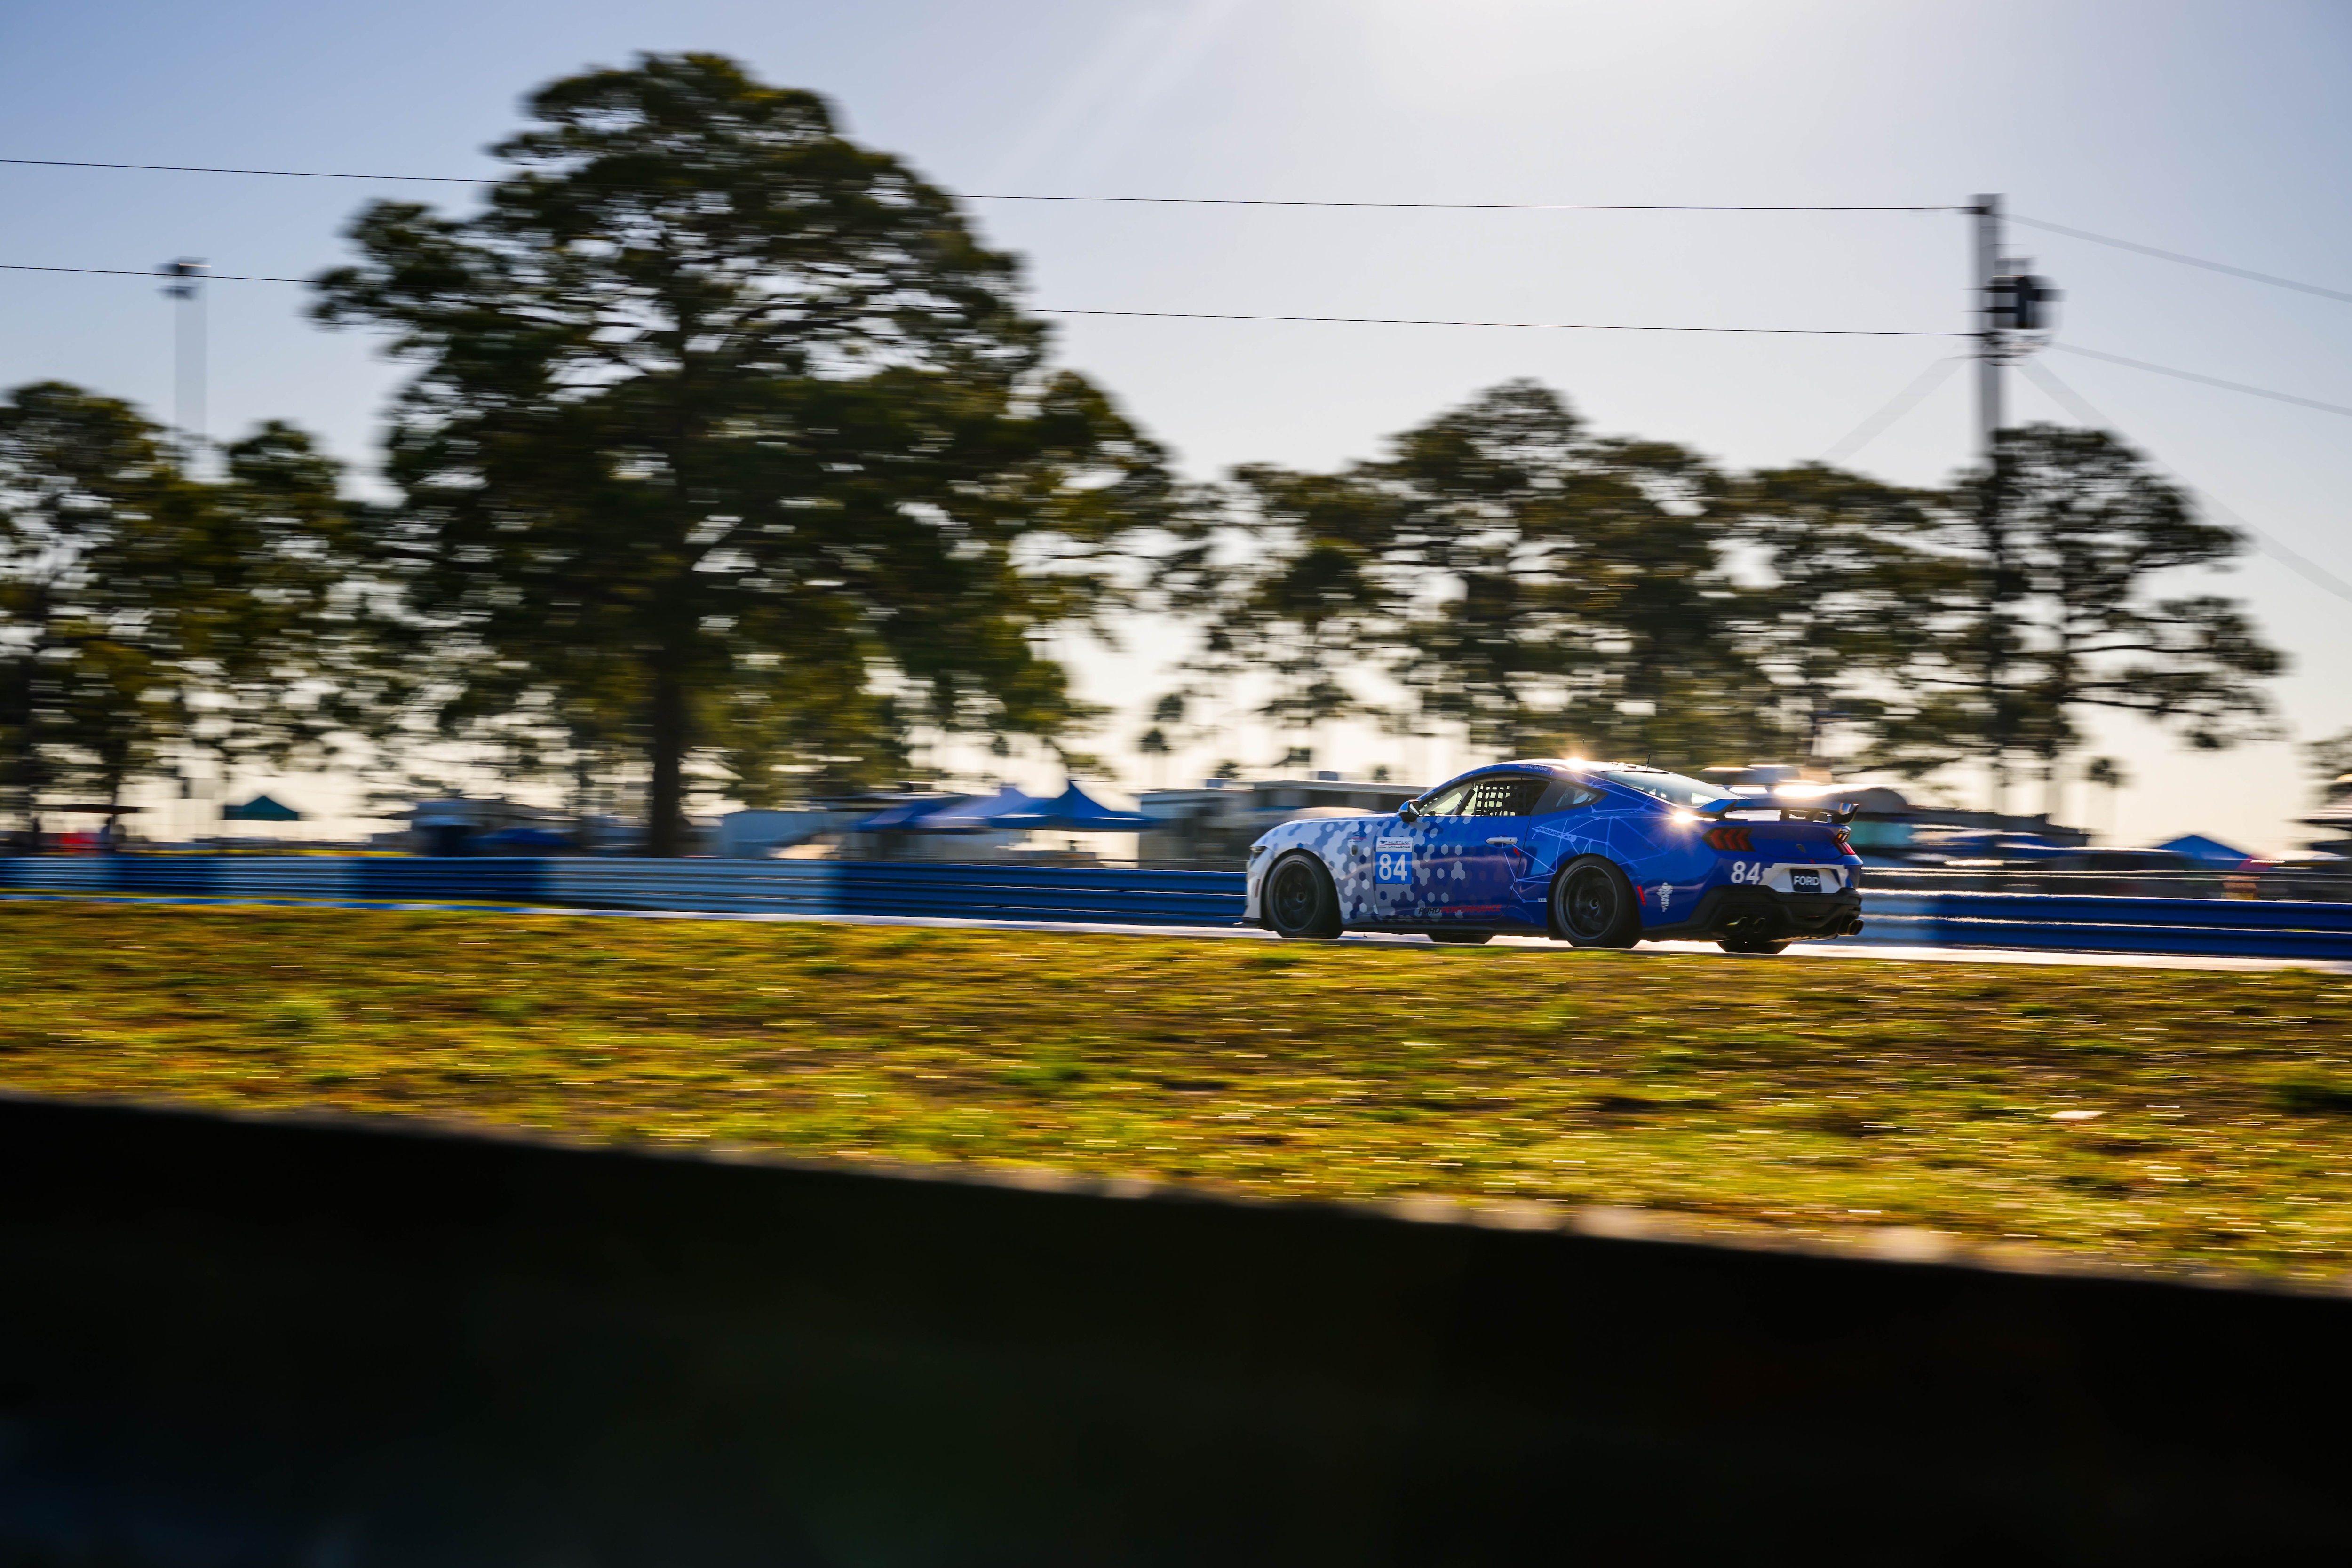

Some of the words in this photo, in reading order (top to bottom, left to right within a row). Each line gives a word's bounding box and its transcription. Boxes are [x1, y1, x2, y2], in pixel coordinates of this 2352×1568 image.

[1379, 853, 1407, 881] 84
[1731, 861, 1761, 884] 84
[1793, 876, 1820, 886] FORD
[1441, 904, 1502, 914] PERFORMANCE
